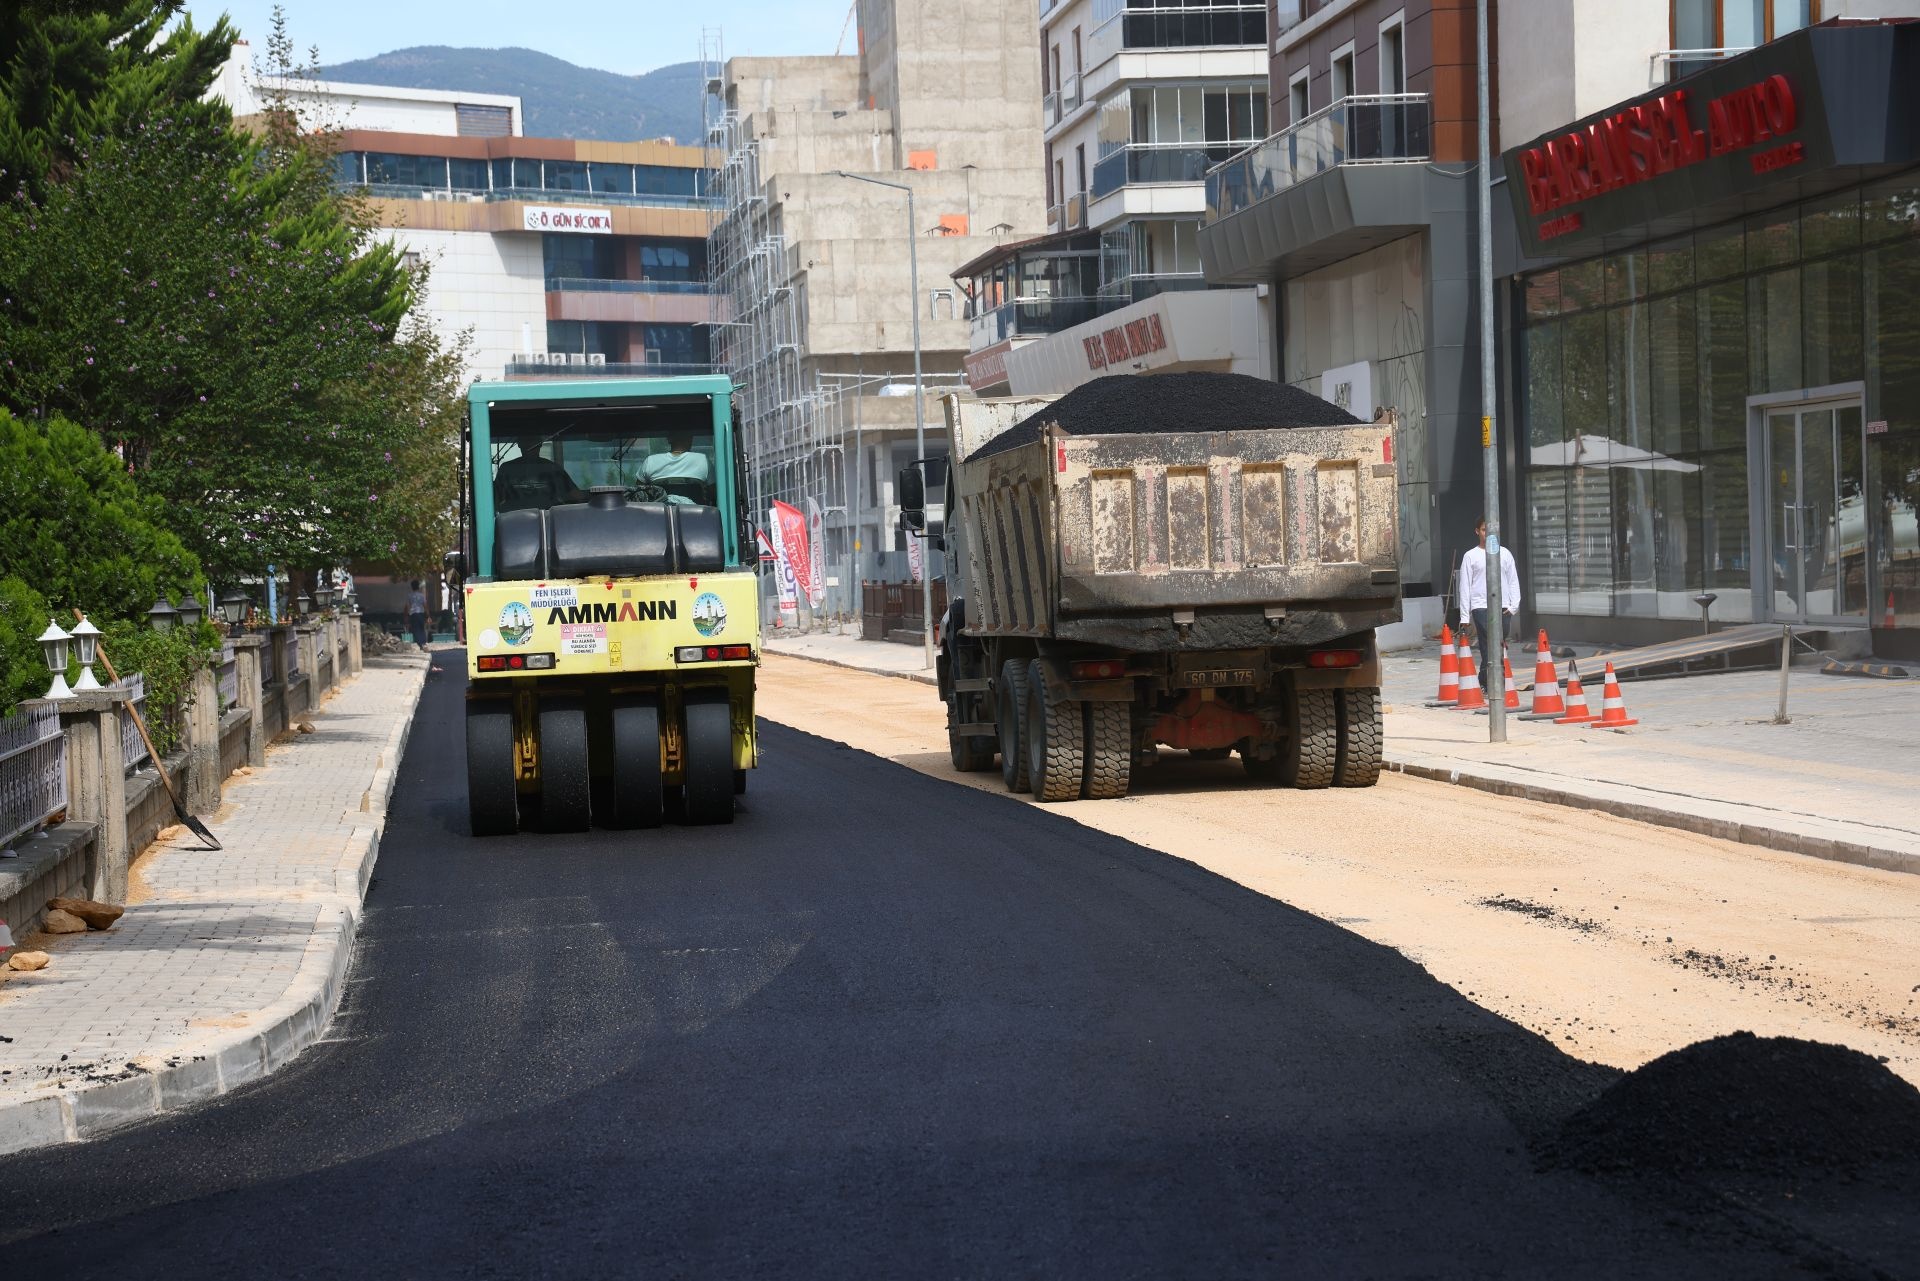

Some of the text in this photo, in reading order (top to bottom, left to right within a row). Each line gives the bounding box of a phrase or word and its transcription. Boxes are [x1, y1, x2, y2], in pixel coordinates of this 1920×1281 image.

[1519, 73, 1797, 216] BARANSEL AUTO
[536, 587, 571, 598] FEN İŞLERİ
[531, 596, 577, 608] MÜDÜRLÜĞÜ
[547, 600, 677, 625] AMMANN
[1191, 672, 1206, 684] 60
[1233, 670, 1252, 682] 175
